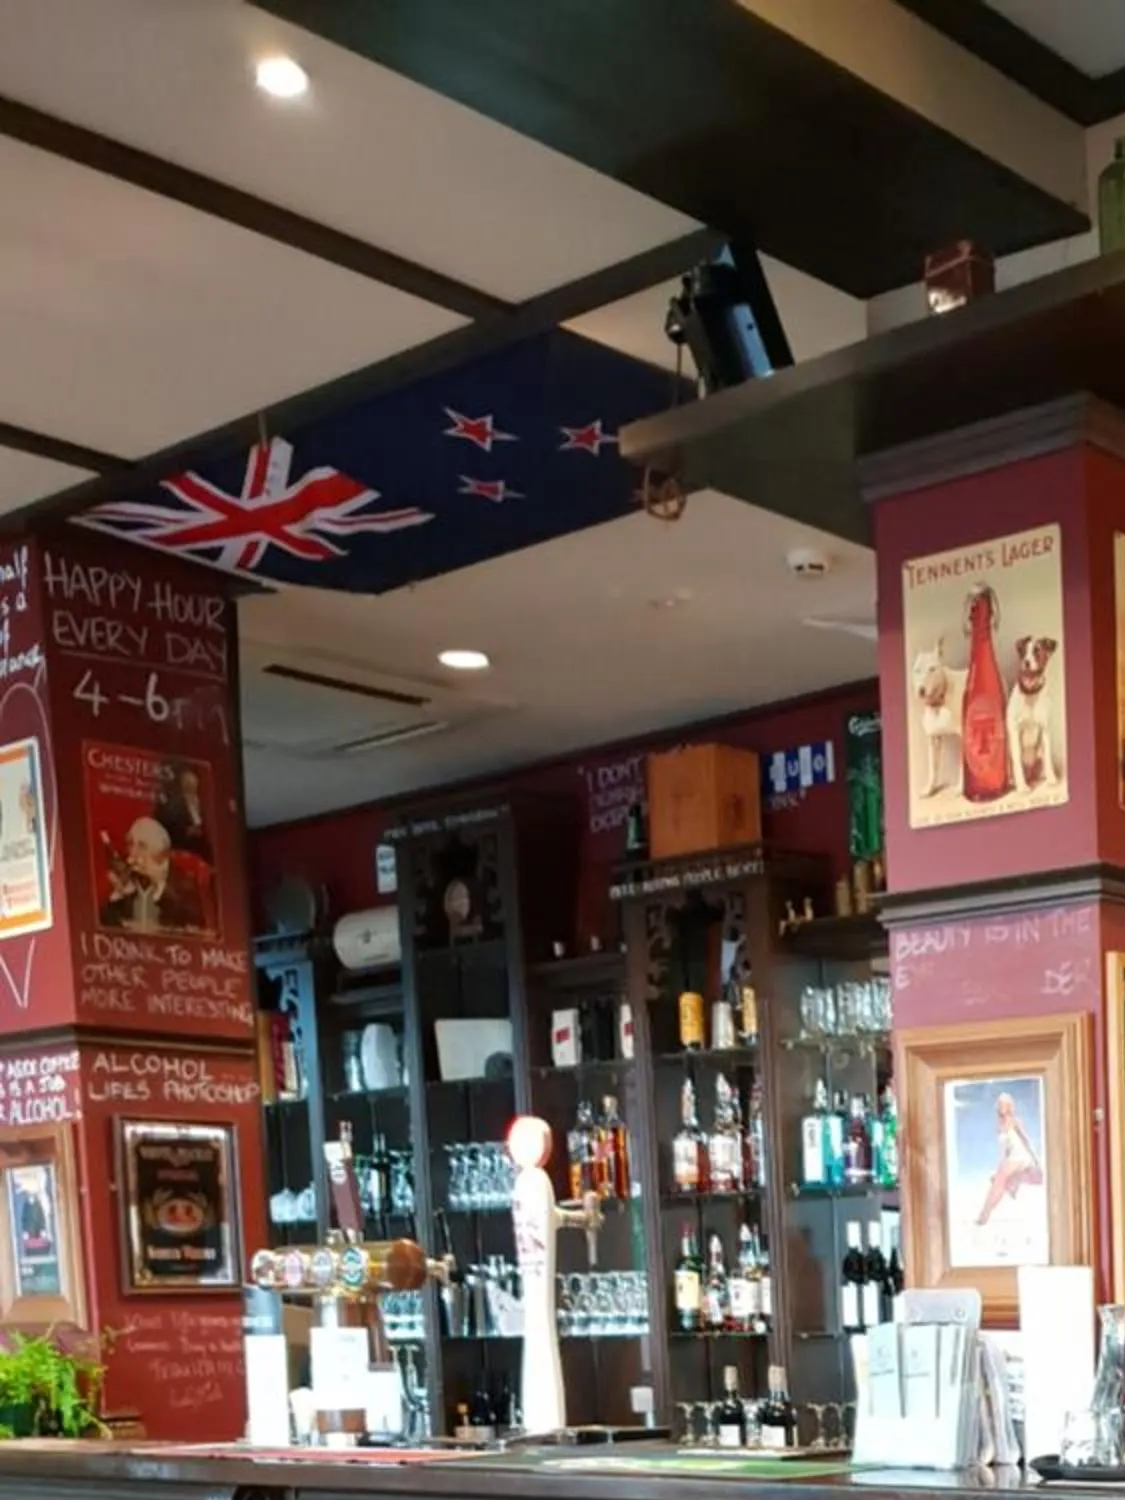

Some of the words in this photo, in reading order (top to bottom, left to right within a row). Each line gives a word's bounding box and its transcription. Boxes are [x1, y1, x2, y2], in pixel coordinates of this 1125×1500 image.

[1001, 534, 1054, 568] LAGER
[44, 551, 142, 612] HAPPY
[148, 582, 226, 632] HOUR
[53, 609, 149, 657] EVERY
[164, 631, 228, 676] DAY
[93, 1052, 214, 1081] ALCOHOL
